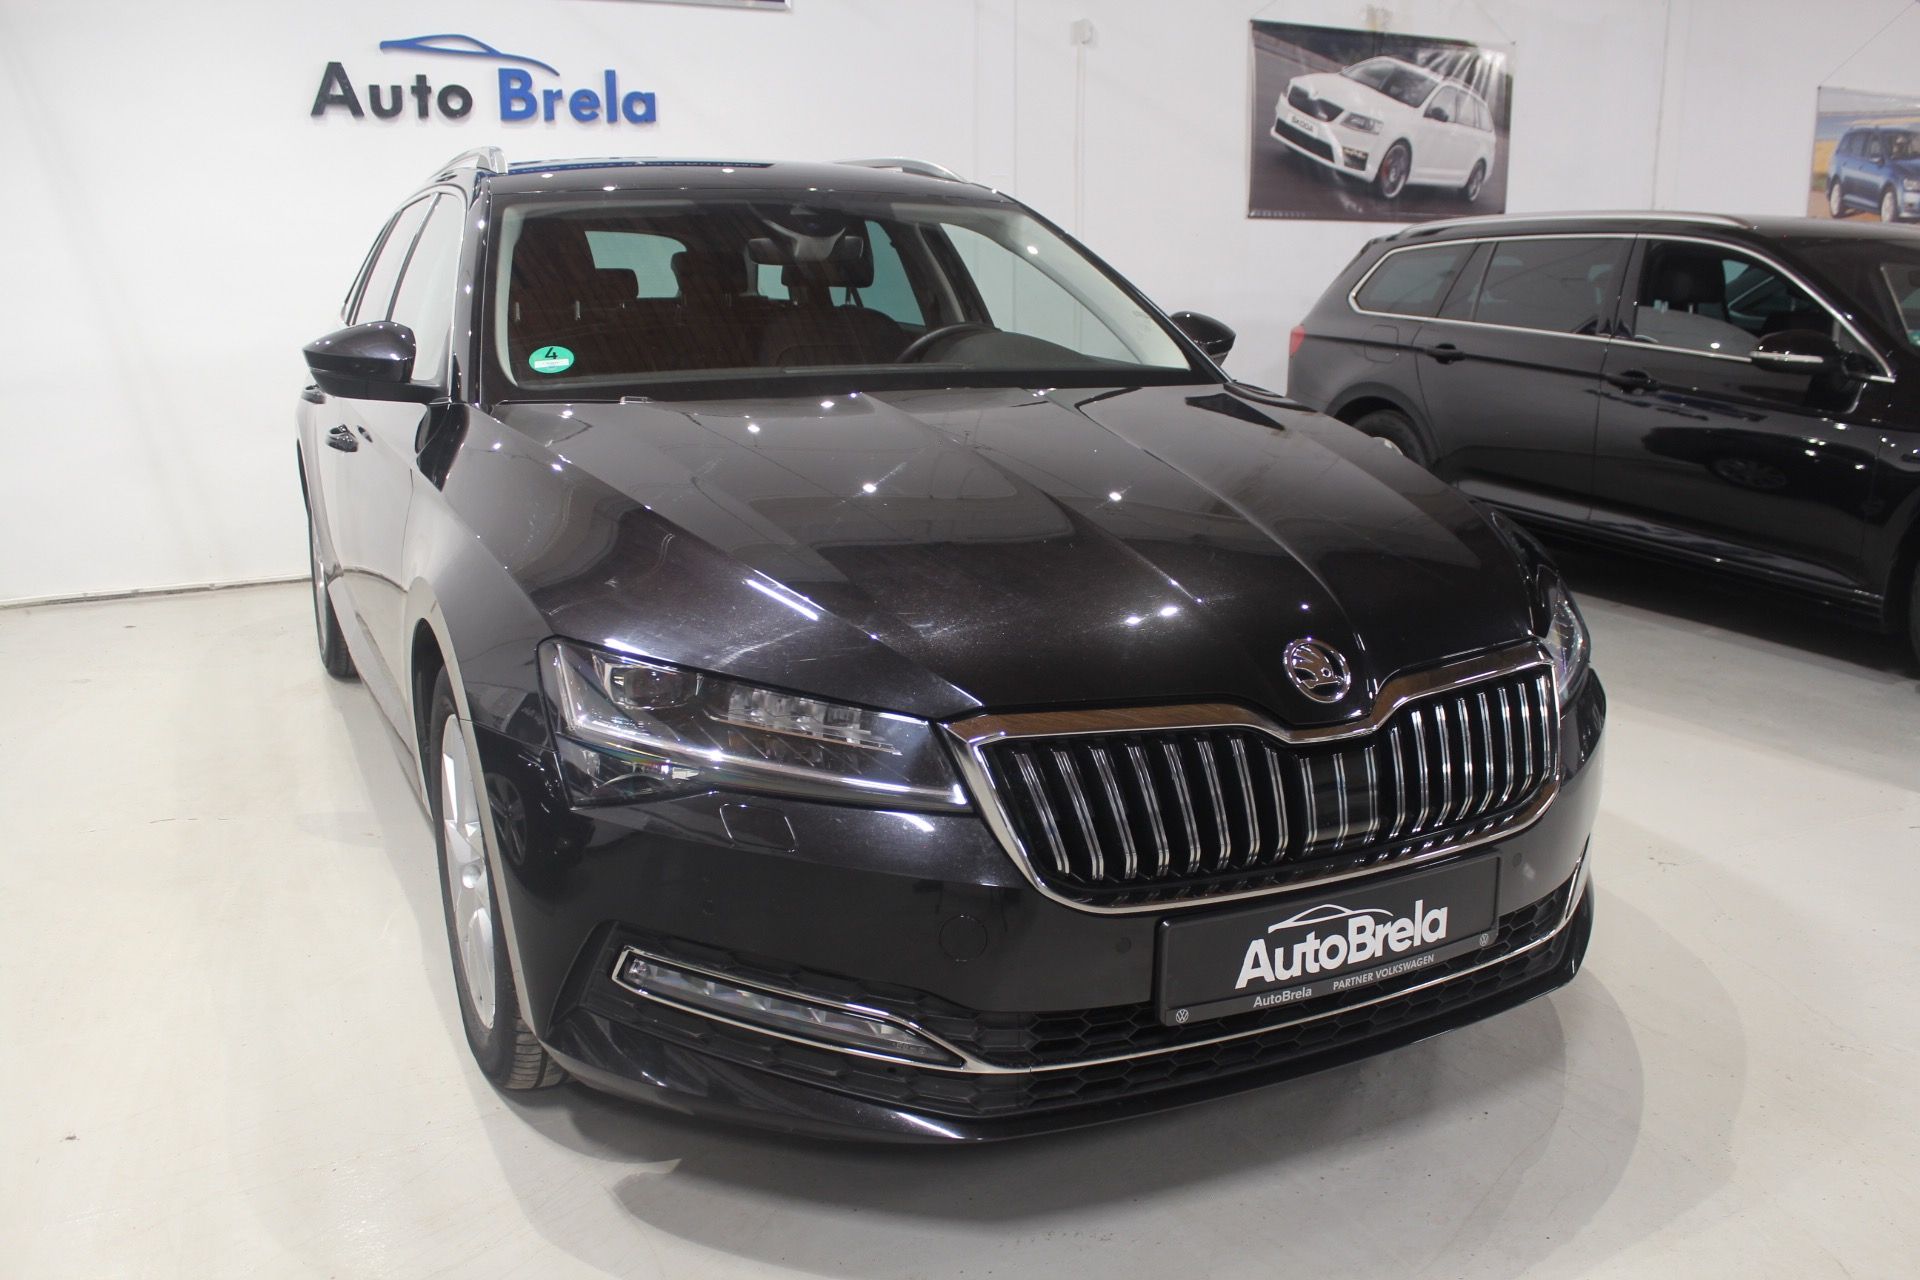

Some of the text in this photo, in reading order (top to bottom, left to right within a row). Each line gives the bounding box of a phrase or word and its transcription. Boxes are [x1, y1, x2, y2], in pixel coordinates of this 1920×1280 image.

[310, 61, 657, 125] Auto Brela
[545, 346, 558, 359] 4
[1234, 899, 1448, 989] AutoBrela
[1253, 953, 1435, 1009] AutoBrela PARTNER VOLKSWAGEN
